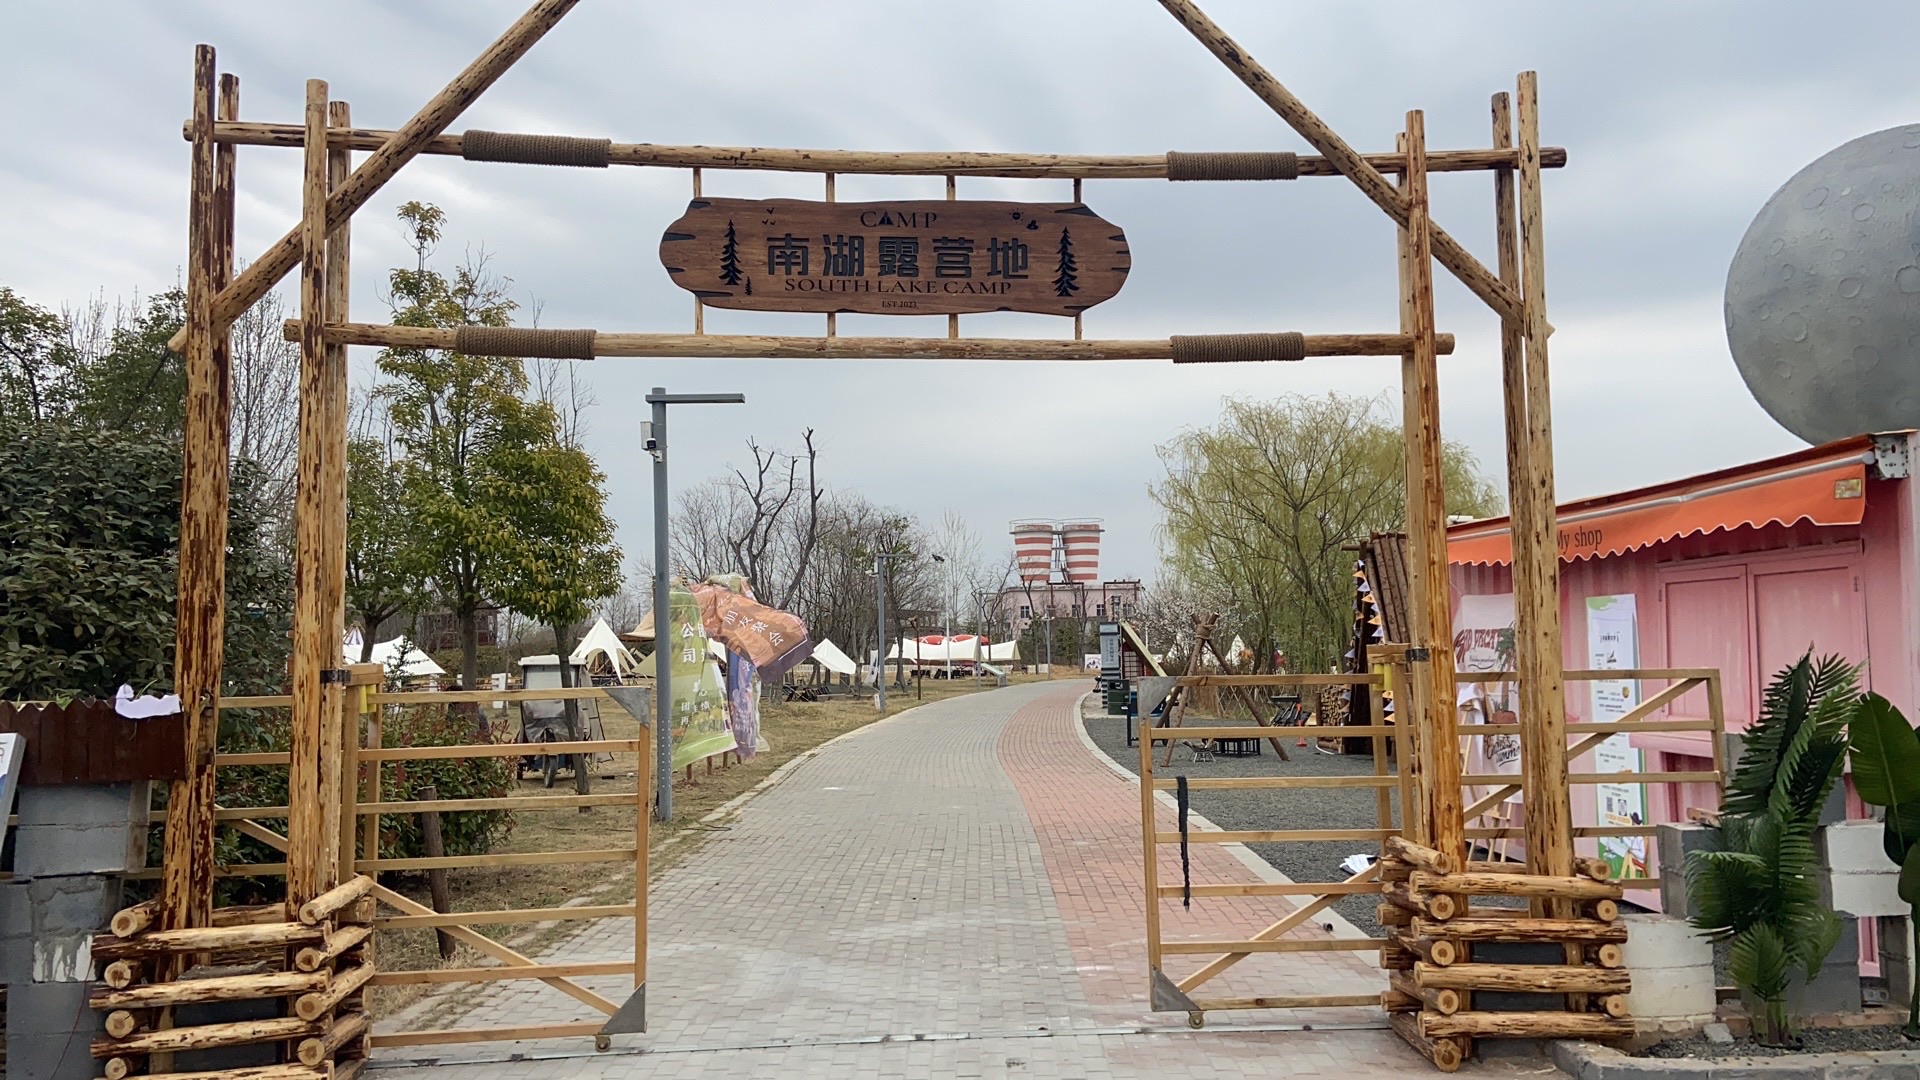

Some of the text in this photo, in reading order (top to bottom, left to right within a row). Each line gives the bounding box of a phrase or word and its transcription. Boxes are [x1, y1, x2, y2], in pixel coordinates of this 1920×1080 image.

[860, 211, 937, 228] CAMP
[766, 233, 1029, 280] 南湖露营地
[785, 278, 1012, 295] SOUTH LAKE CAMP
[1574, 525, 1603, 551] shop
